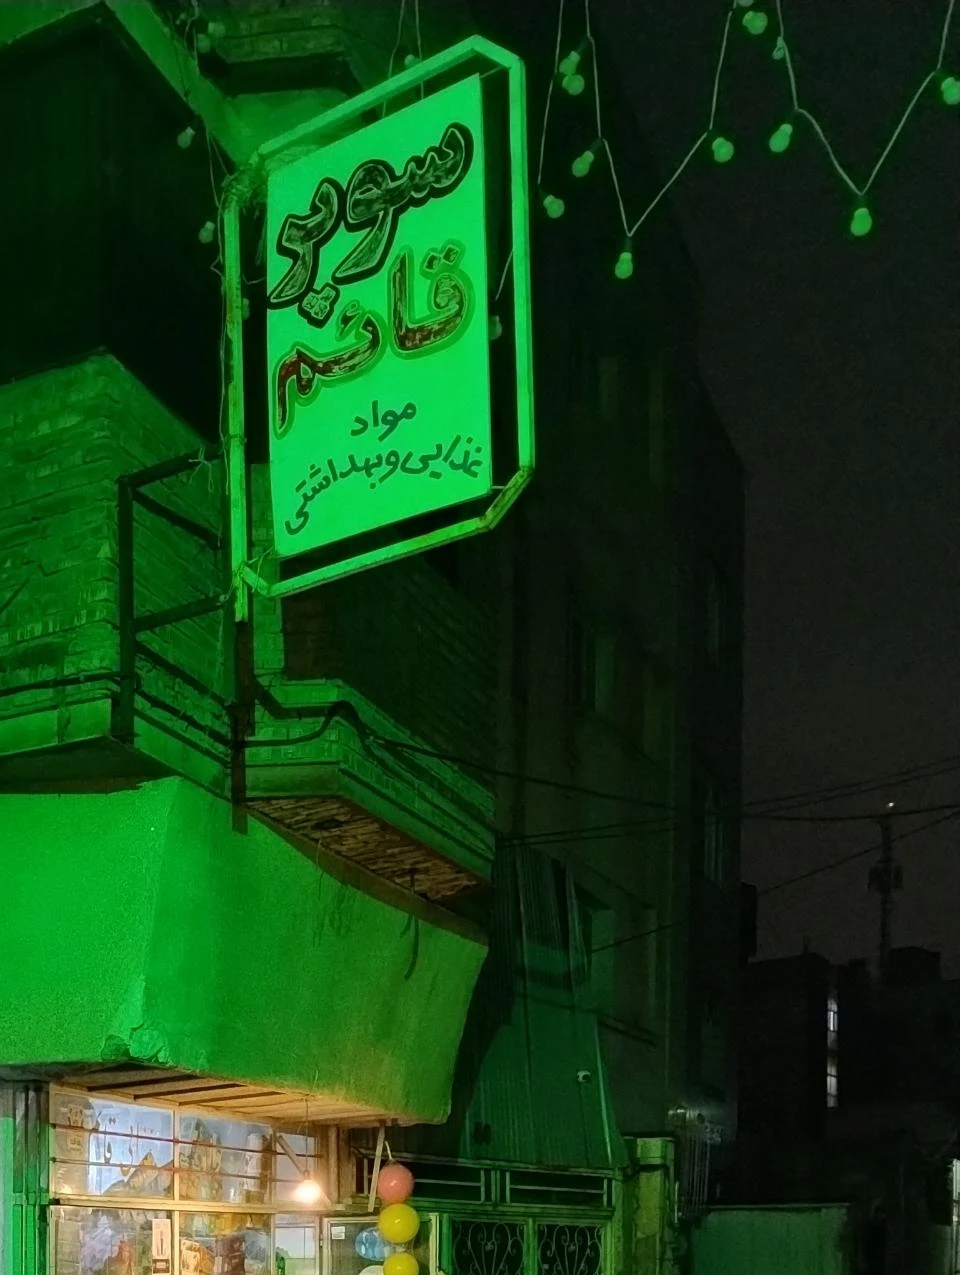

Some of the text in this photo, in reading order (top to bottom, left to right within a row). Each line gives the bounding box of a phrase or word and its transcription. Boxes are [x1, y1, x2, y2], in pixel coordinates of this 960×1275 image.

[268, 121, 474, 328] سوپر
[273, 240, 471, 438] قائم
[350, 399, 417, 442] مواد
[284, 453, 384, 536] بهداشتی
